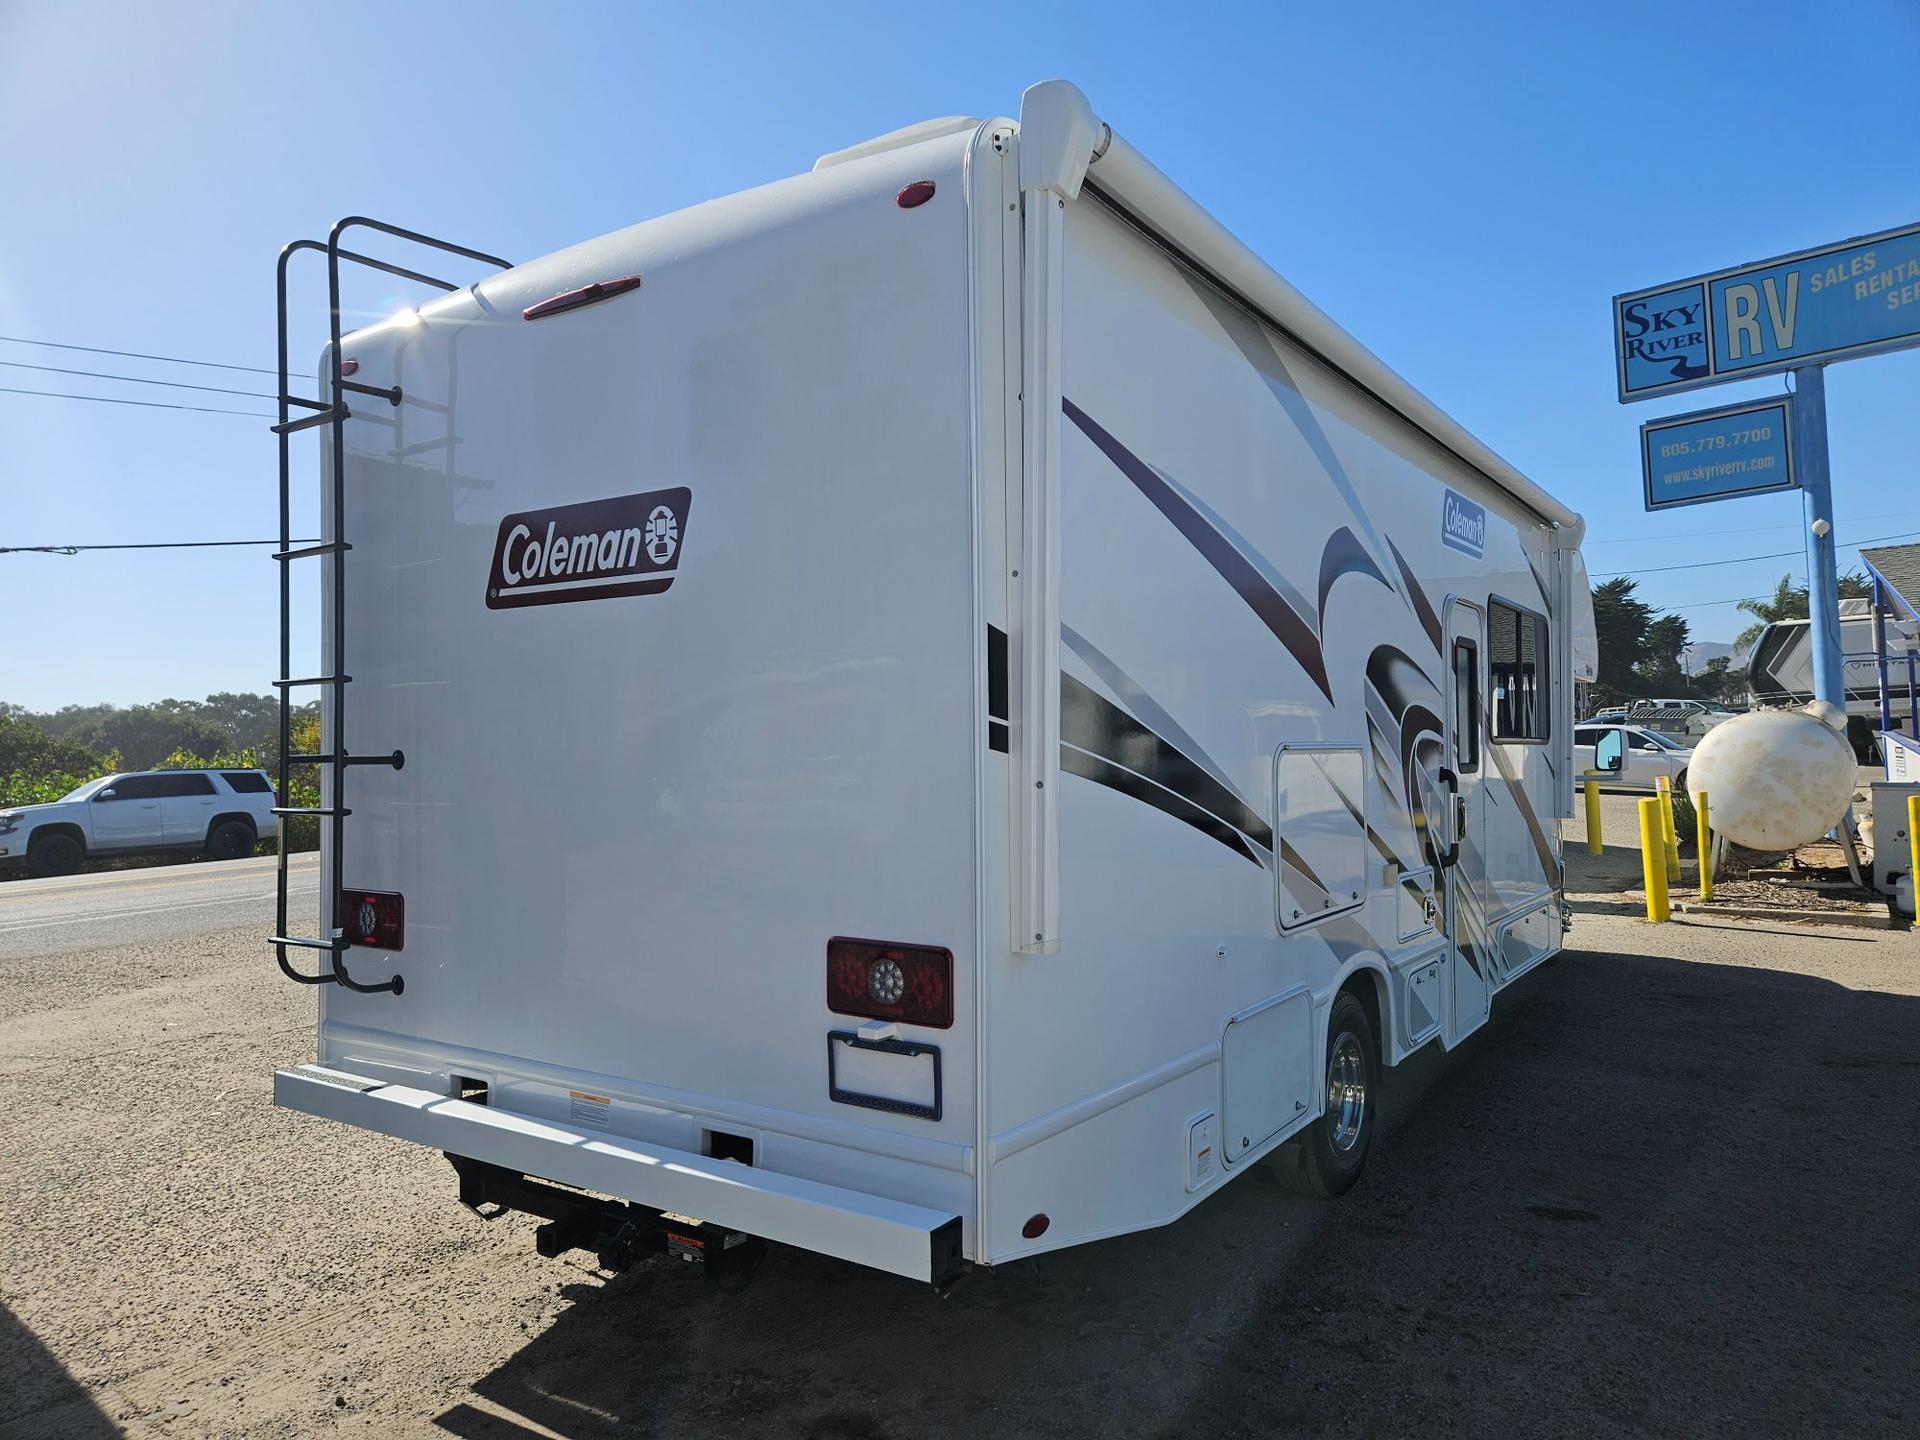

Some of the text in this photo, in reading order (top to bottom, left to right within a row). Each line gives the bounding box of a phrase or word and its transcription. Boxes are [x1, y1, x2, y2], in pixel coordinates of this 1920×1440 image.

[1811, 252, 1876, 292] SALES
[1625, 303, 1700, 338] SKY
[1724, 271, 1800, 360] RV
[1626, 332, 1704, 361] RIVER
[1661, 427, 1771, 458] 805.779.7700
[1663, 456, 1775, 485] www.skyriverrv.com
[1445, 496, 1477, 542] Coleman
[503, 521, 641, 585] Coleman
